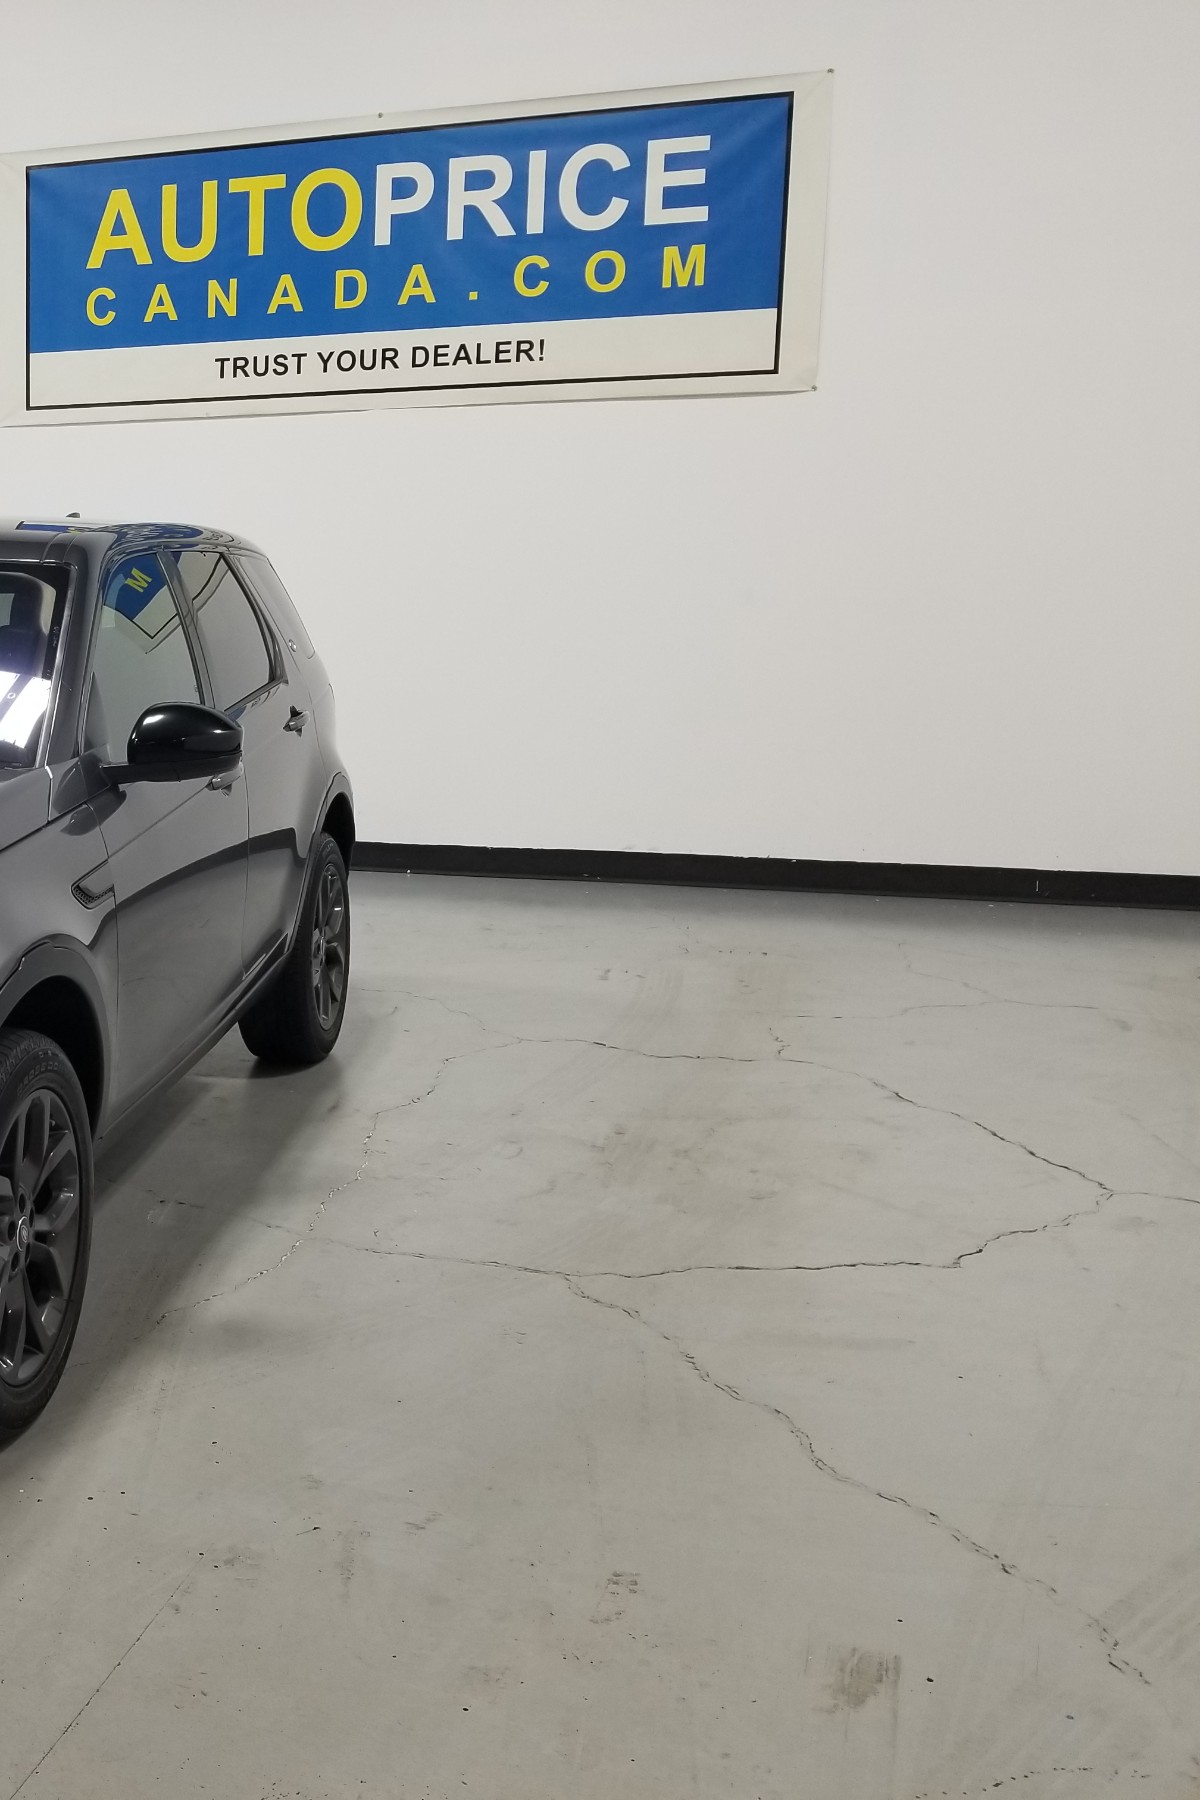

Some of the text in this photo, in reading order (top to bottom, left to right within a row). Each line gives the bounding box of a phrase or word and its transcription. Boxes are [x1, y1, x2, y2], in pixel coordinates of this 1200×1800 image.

[86, 134, 712, 269] AUTOPRICE
[214, 338, 547, 380] TRUST YOUR DEALER!
